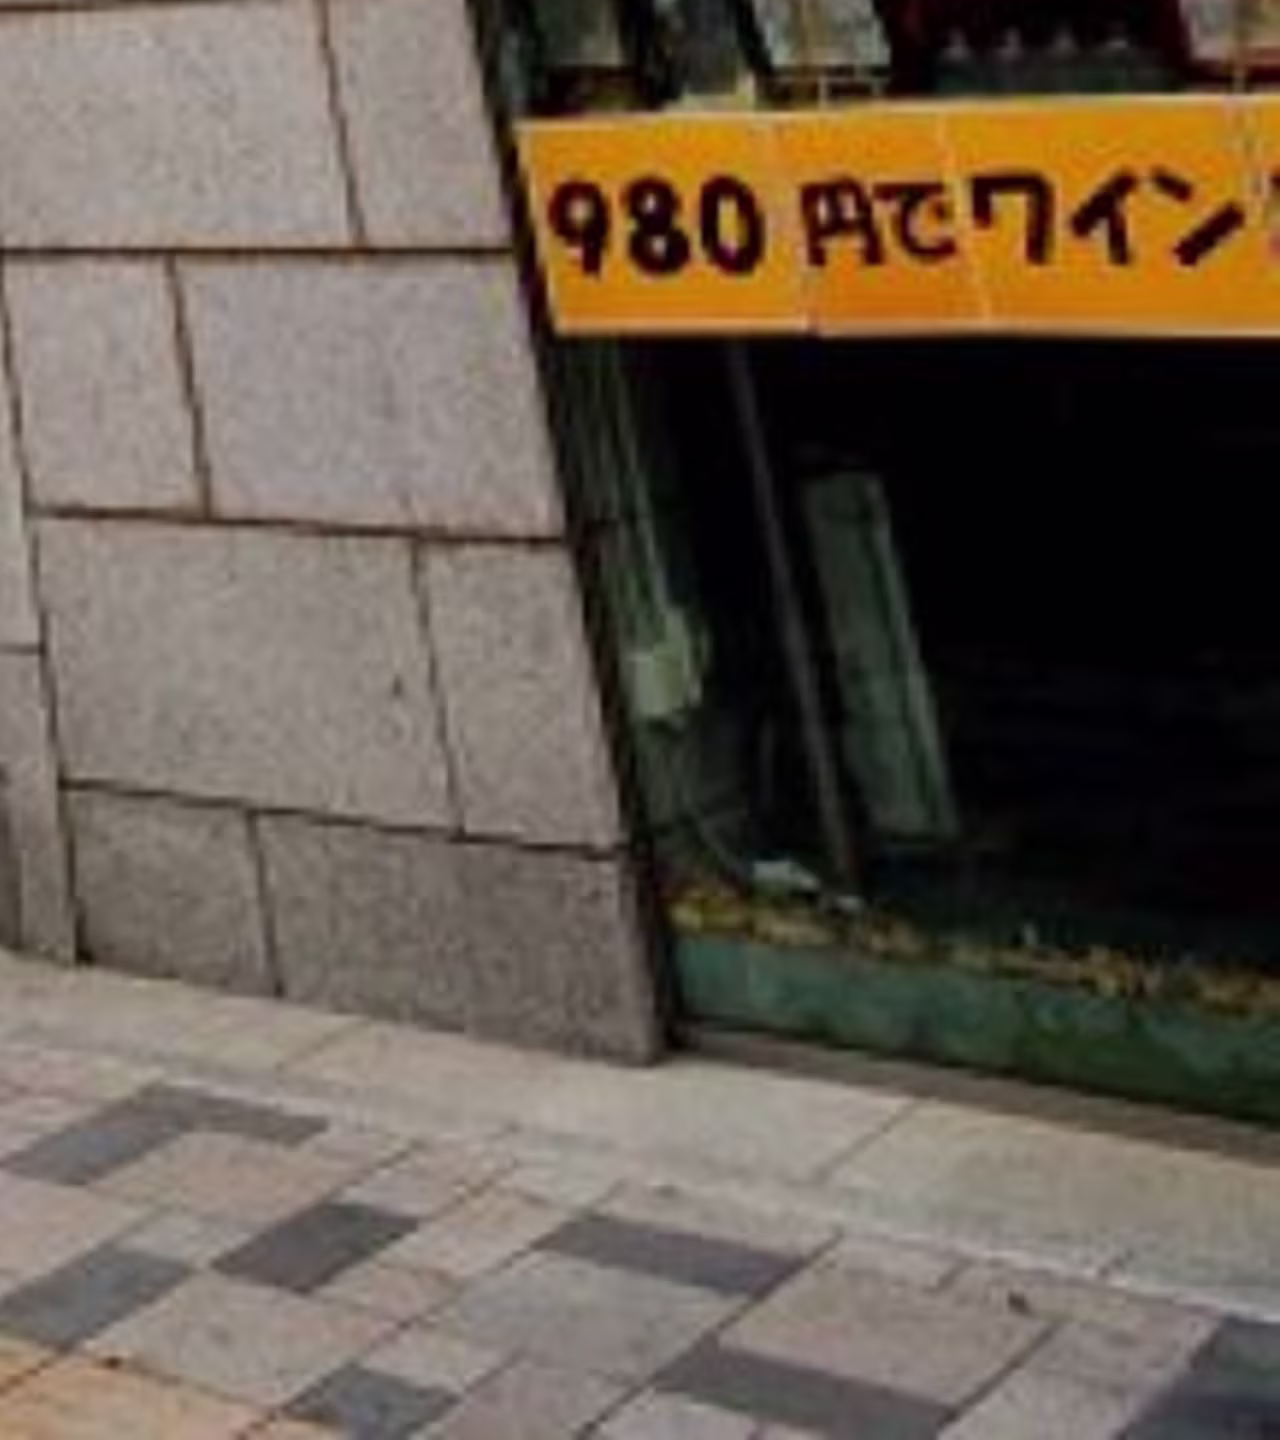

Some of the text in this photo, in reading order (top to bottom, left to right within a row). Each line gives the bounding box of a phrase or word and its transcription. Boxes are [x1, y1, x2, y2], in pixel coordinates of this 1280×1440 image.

[800, 168, 1280, 266] 円でワイン
